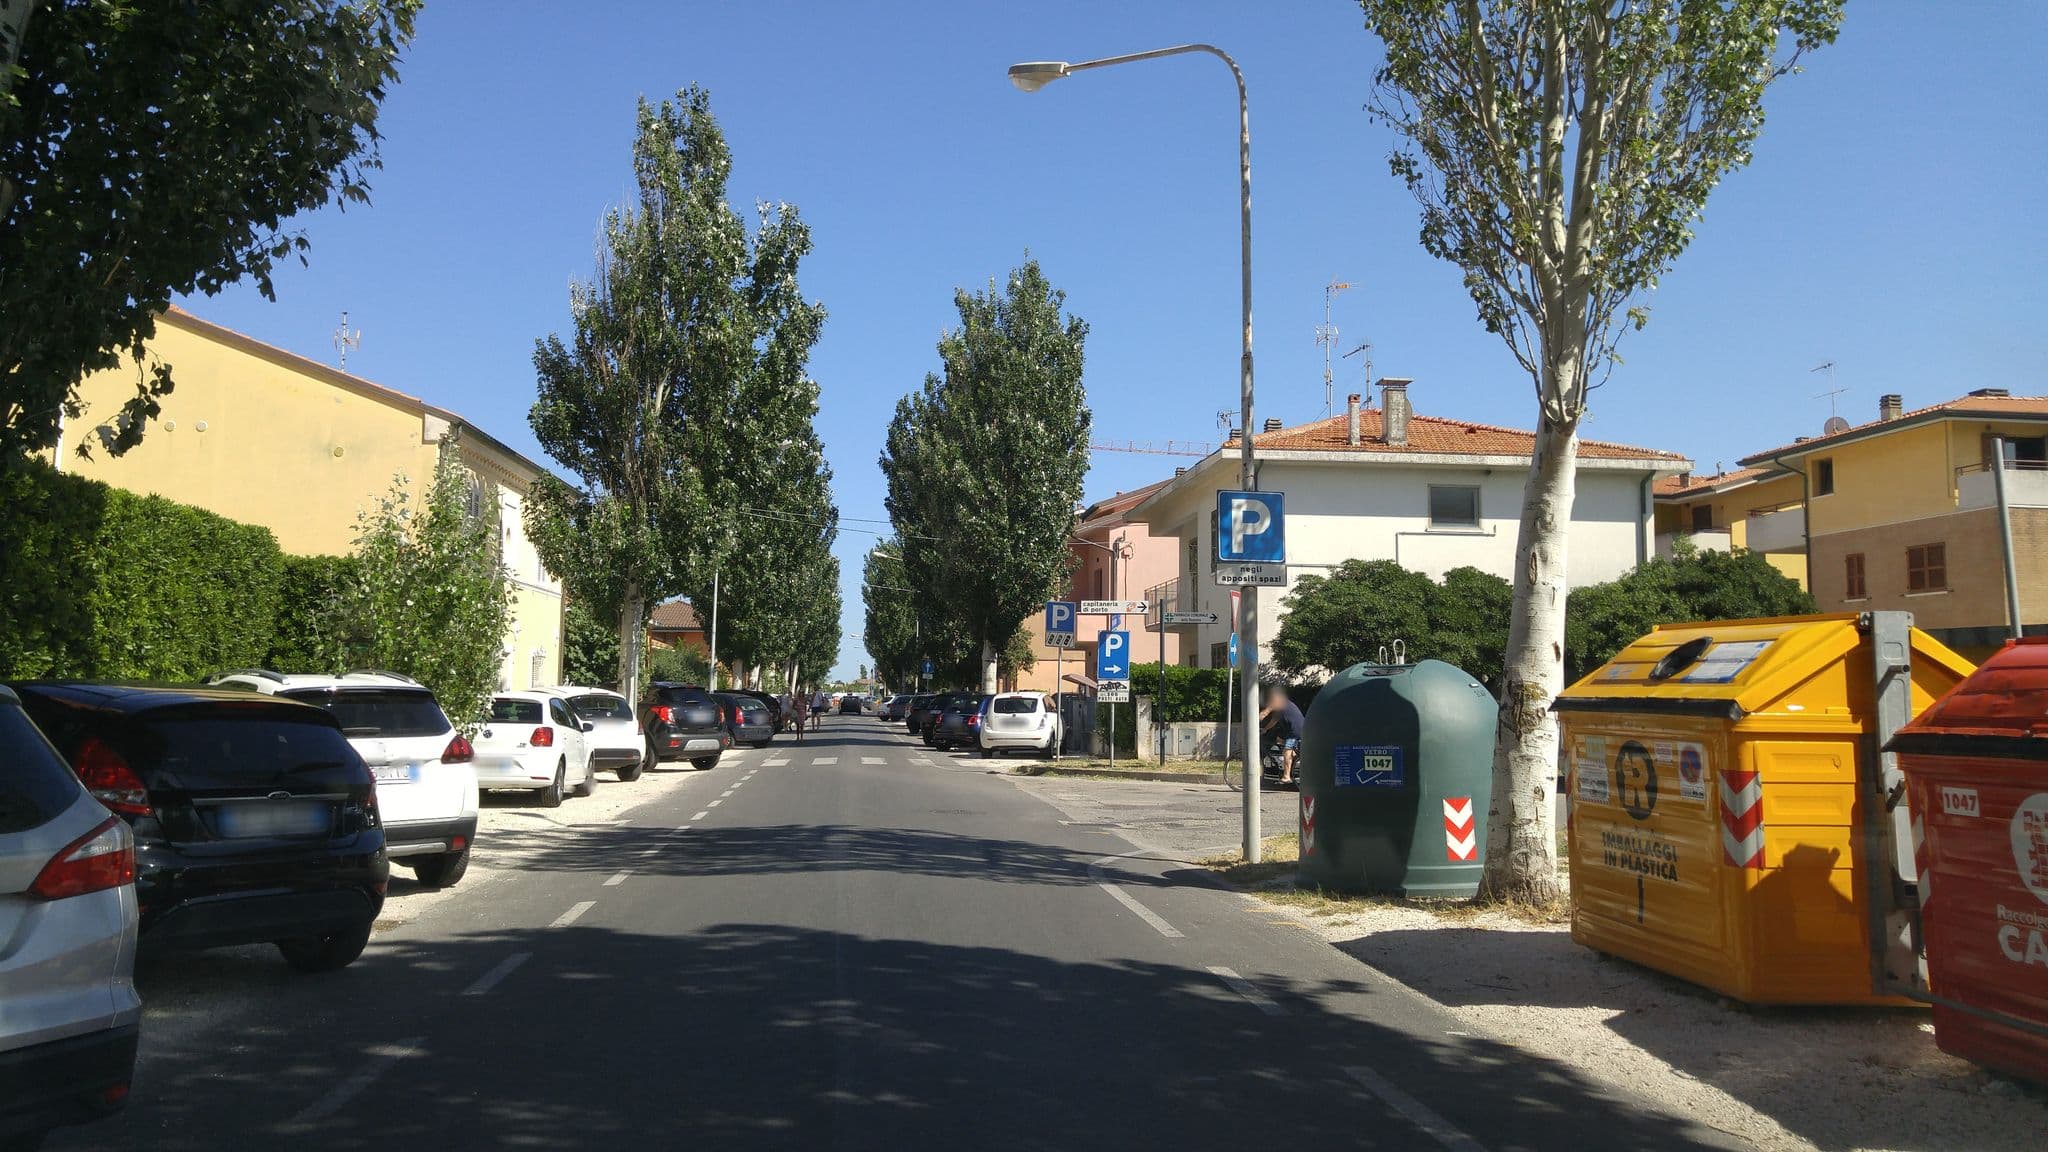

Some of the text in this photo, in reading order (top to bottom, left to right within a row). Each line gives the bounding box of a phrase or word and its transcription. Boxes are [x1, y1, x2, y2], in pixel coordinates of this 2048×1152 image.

[1232, 499, 1271, 553] P
[1222, 575, 1257, 583] appositi
[1240, 566, 1262, 574] negli
[1051, 605, 1070, 629] P
[1105, 634, 1122, 657] P
[1365, 759, 1392, 768] 1047
[1943, 792, 1977, 812] 1047
[1602, 832, 1678, 863] IMBALLAGGI
[1604, 850, 1678, 882] IN PLASTICA
